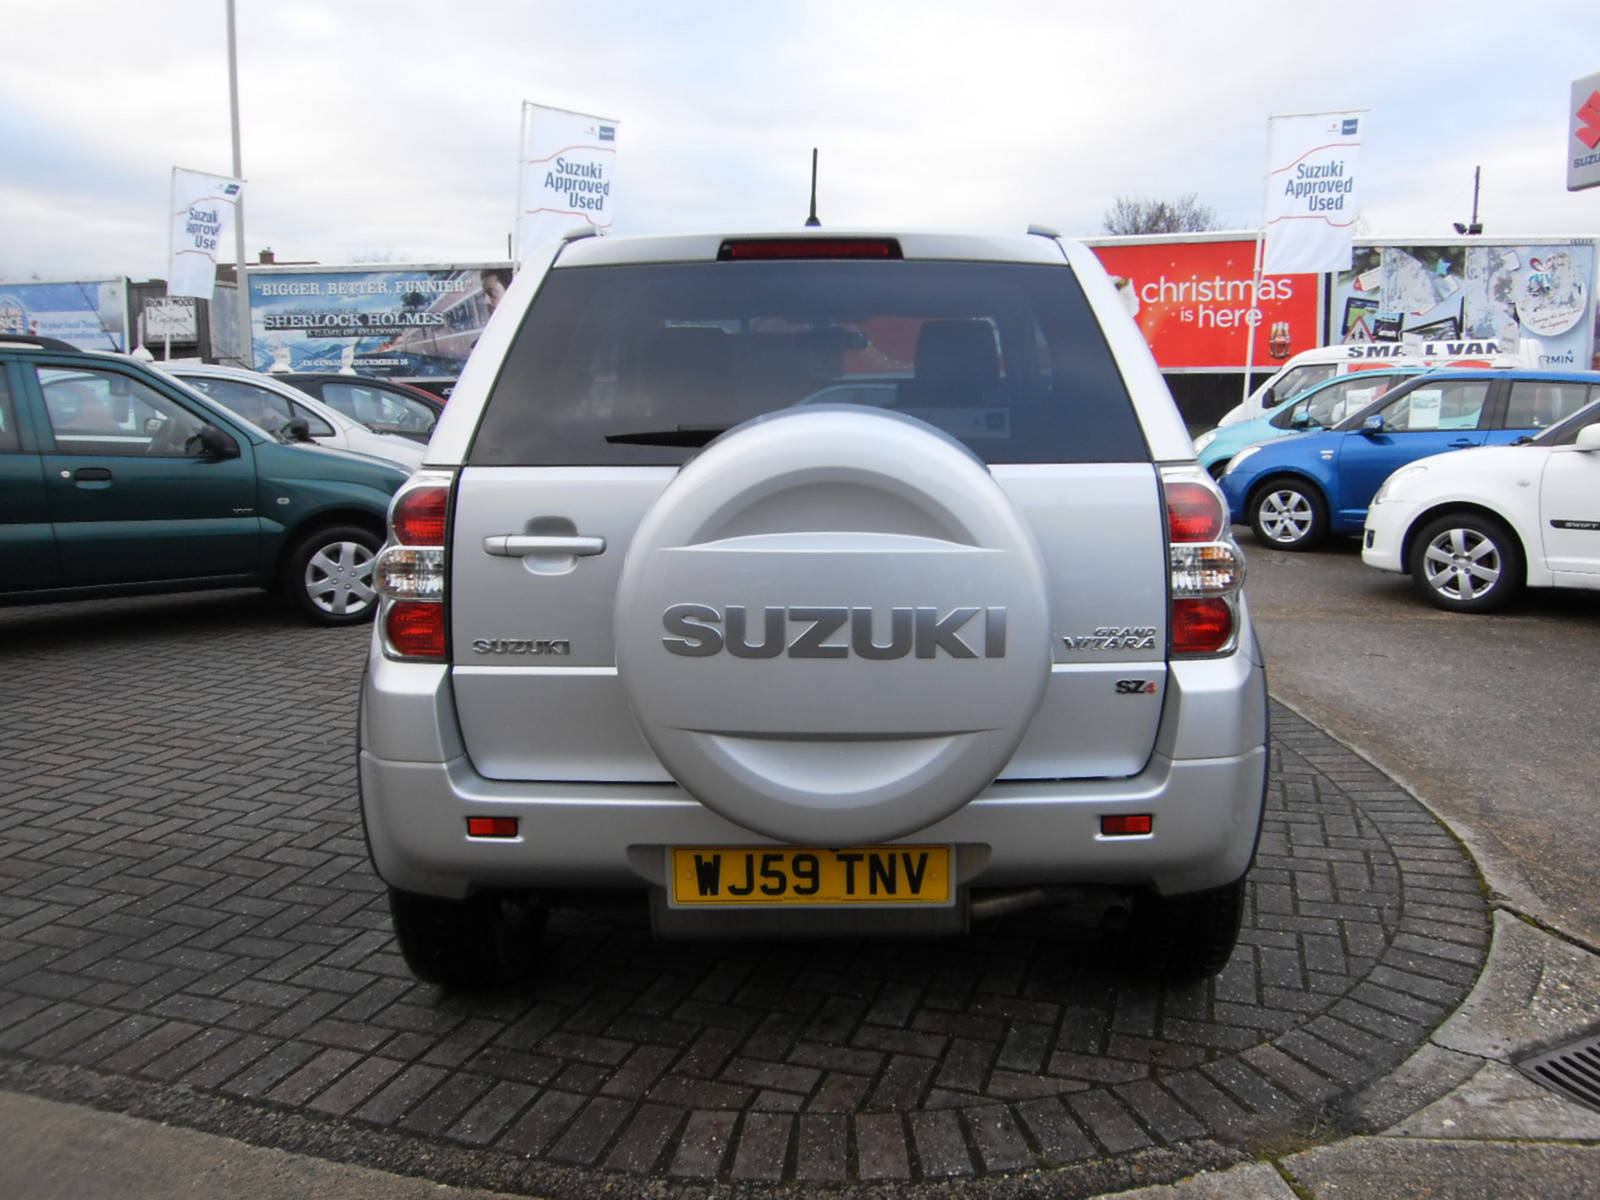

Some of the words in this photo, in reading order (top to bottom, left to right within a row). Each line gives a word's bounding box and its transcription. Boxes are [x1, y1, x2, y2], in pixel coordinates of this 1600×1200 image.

[556, 156, 603, 179] Suzuki
[1296, 160, 1344, 180] Suzuki
[544, 171, 610, 196] Approved
[1285, 176, 1353, 199] Approved
[569, 191, 604, 211] Used
[1308, 194, 1344, 212] Used
[327, 281, 392, 296] BETTER,
[1141, 274, 1293, 304] christmas
[264, 313, 362, 328] SHERLOCK
[366, 311, 444, 326] HOLMES
[1180, 306, 1194, 322] is
[1198, 304, 1262, 328] here
[1347, 342, 1437, 358] SMAL
[662, 602, 1007, 660] SUZUKI
[1093, 626, 1156, 638] GRAND
[472, 638, 570, 656] SUZUKI
[1062, 635, 1156, 651] VITARA
[1115, 679, 1156, 694] SZ4
[693, 853, 820, 896] WJ59
[836, 853, 929, 896] TNV
